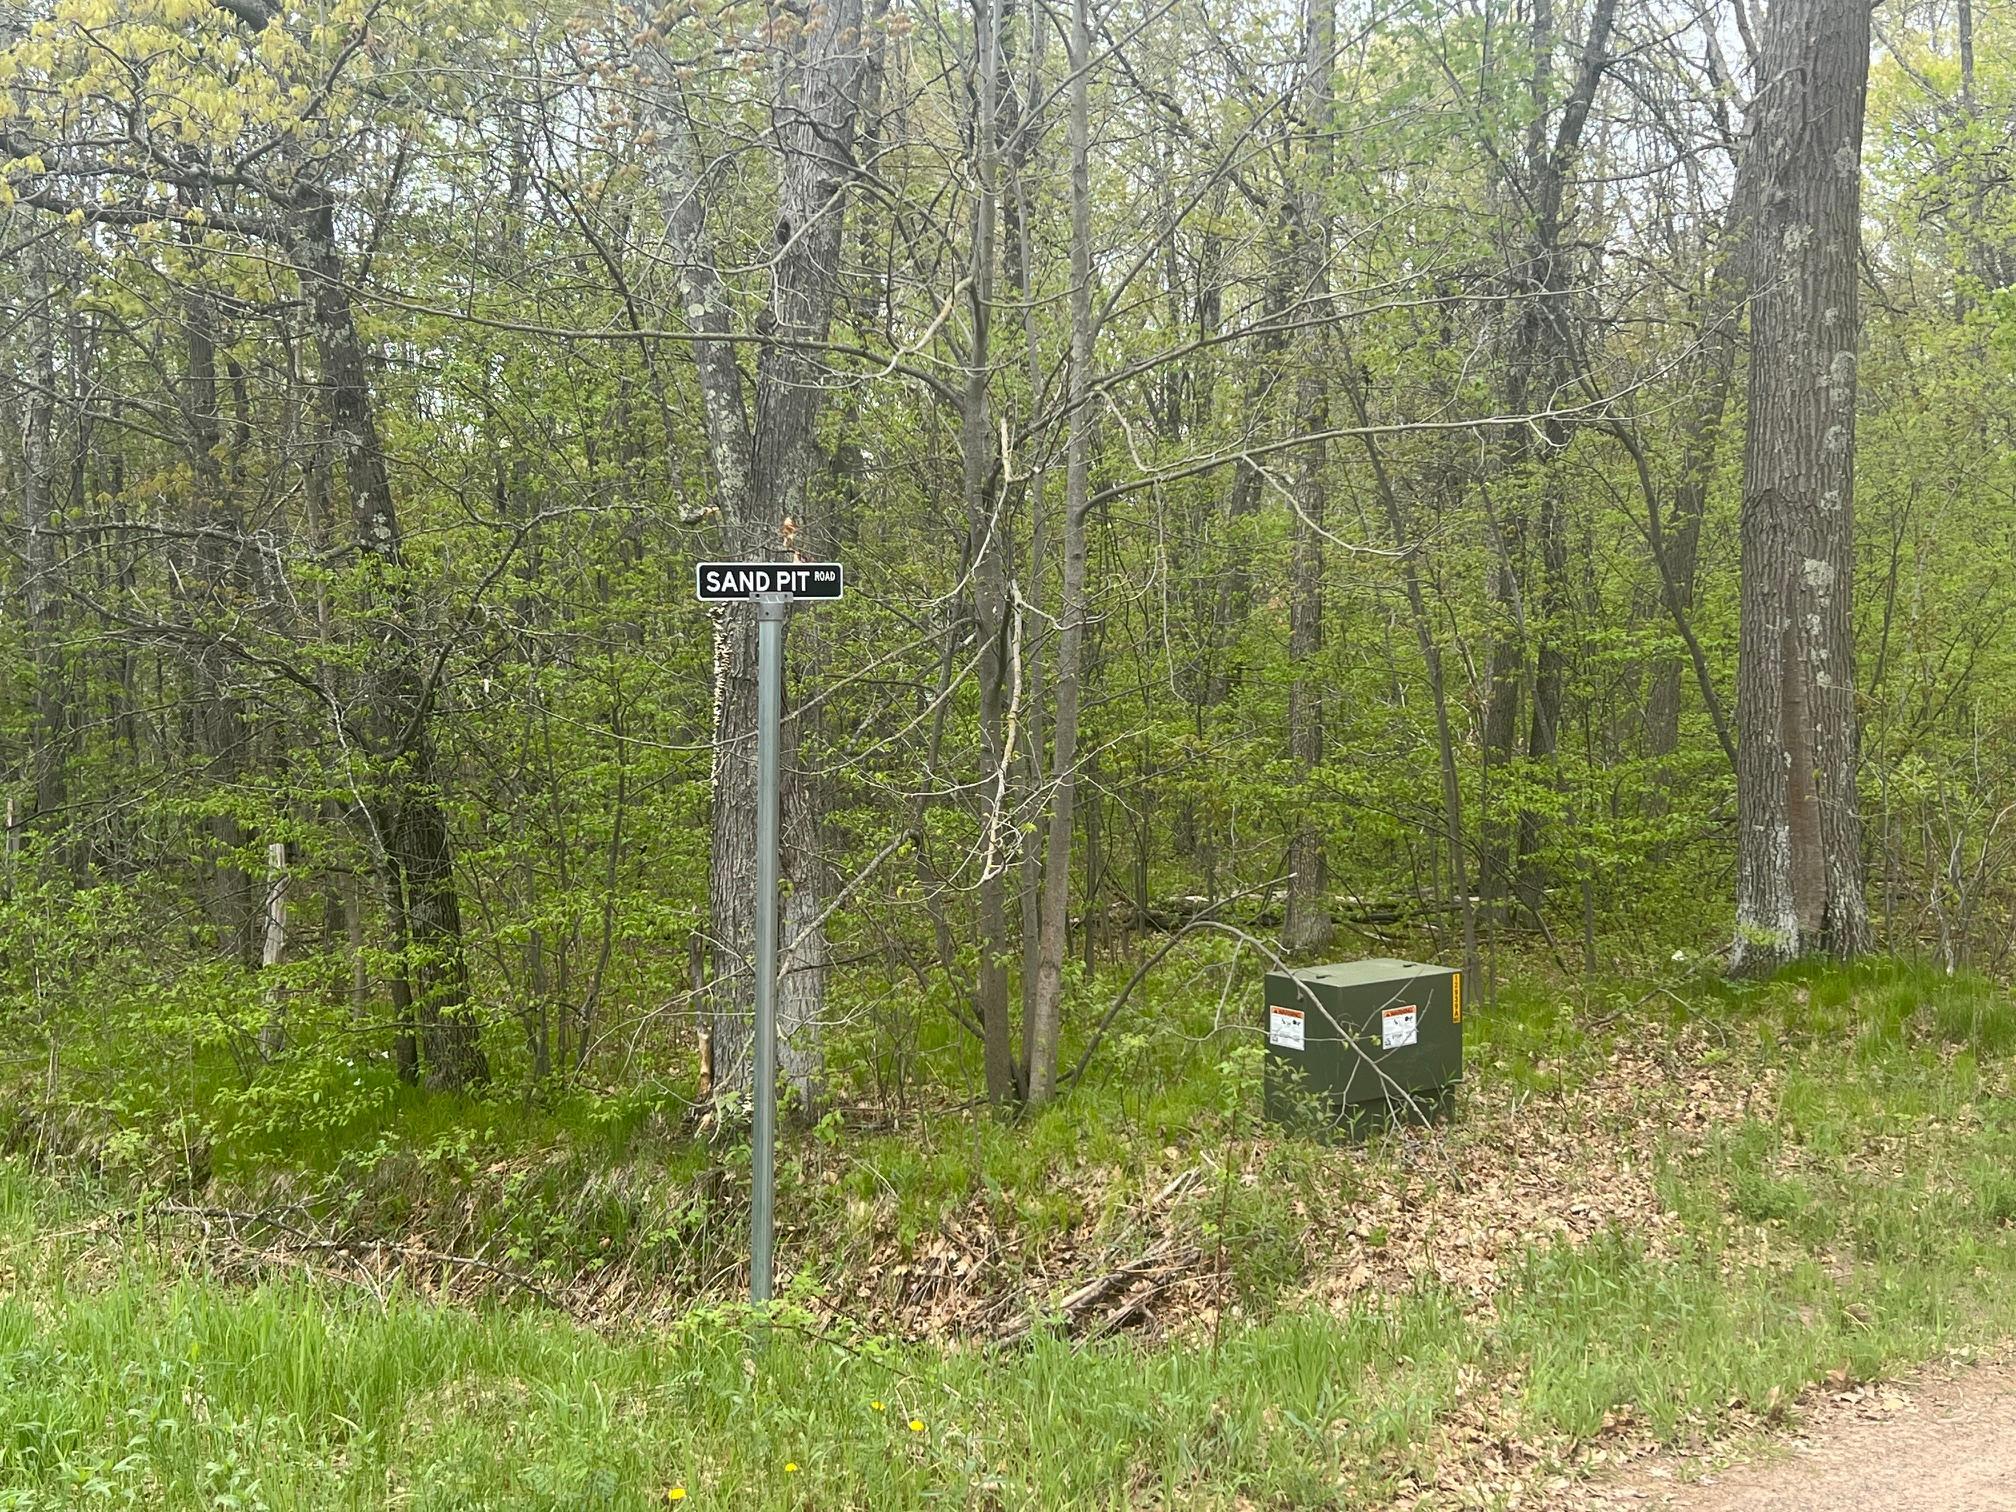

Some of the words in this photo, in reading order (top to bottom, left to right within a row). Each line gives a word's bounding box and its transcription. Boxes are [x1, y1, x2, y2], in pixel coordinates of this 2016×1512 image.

[706, 570, 770, 592] SAND
[776, 570, 810, 592] PIT
[814, 570, 836, 581] ROAD
